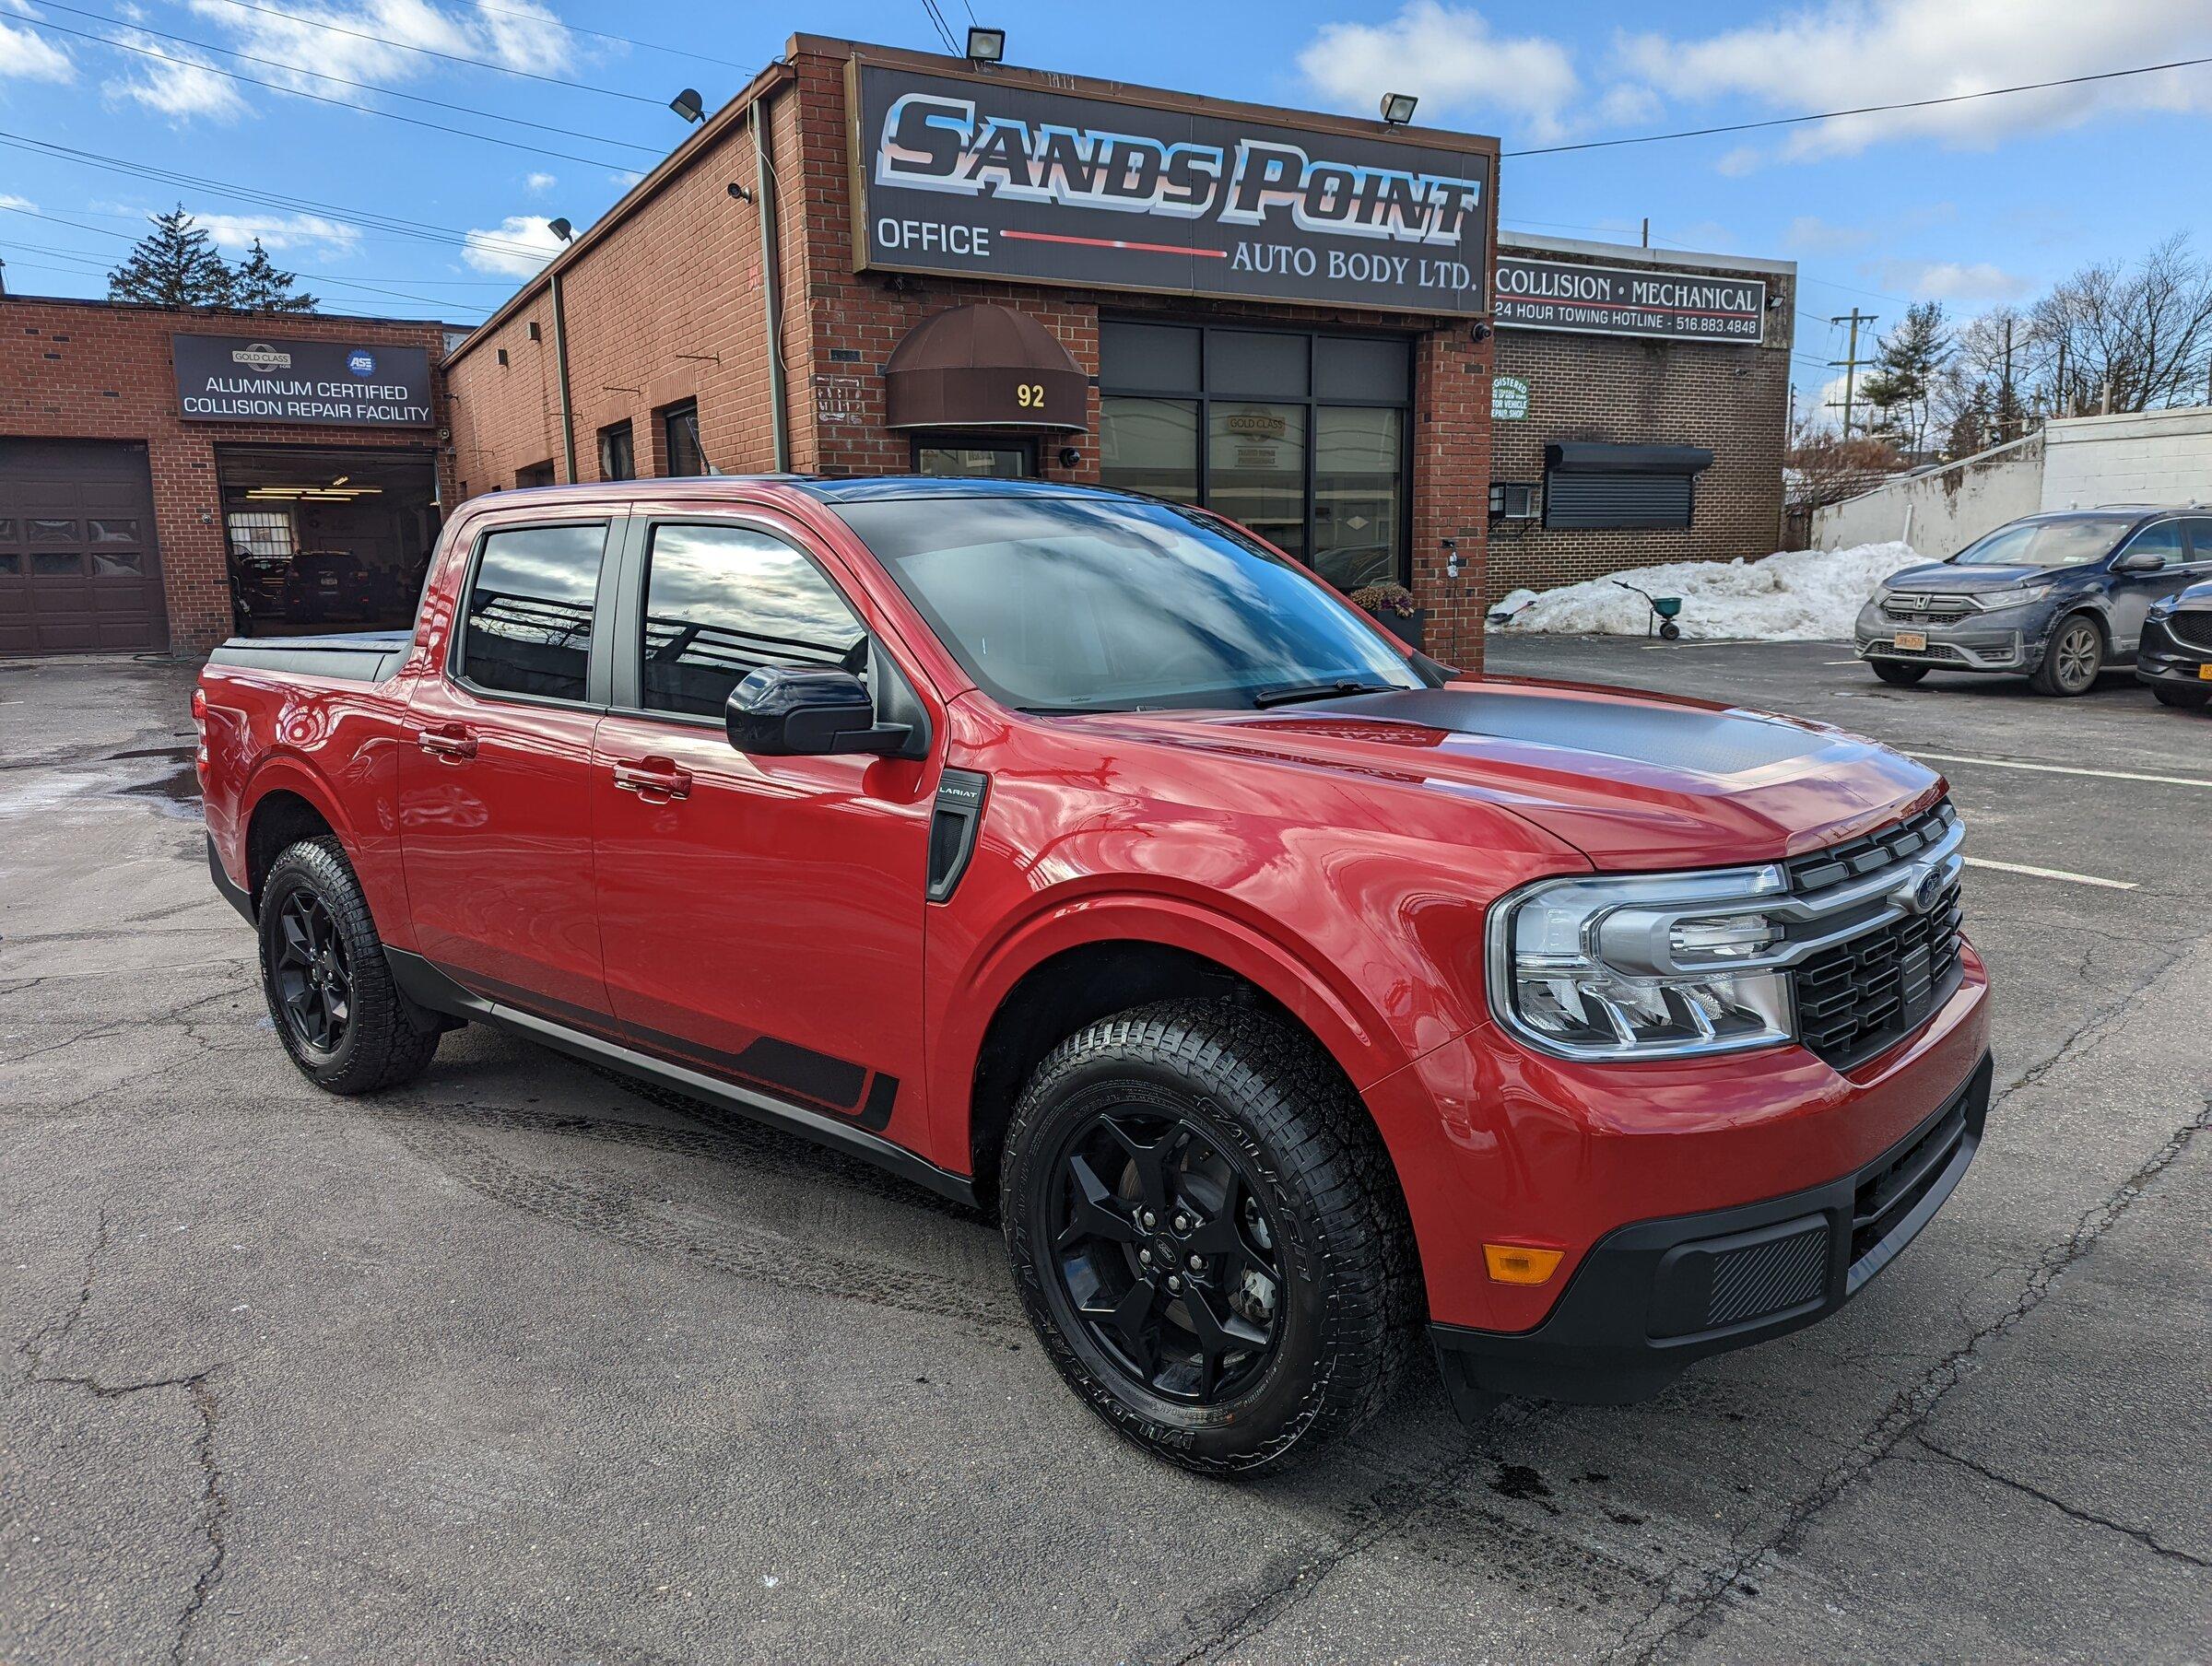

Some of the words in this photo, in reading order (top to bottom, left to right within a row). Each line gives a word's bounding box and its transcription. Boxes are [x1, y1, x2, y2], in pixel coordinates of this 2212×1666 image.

[875, 93, 1224, 219] SANDS
[1217, 138, 1481, 246] POINT
[877, 217, 990, 256] OFFICE
[1231, 241, 1317, 276] AUTO
[1327, 250, 1410, 285] BODY
[1418, 259, 1477, 291] LTD.
[1495, 267, 1611, 301] COLLISION
[1631, 281, 1758, 311] MECHANICAL
[1495, 301, 1512, 316] 24
[1517, 305, 1554, 321] HOUR
[1558, 307, 1608, 324] TOWING
[1612, 311, 1664, 329] HOTLINE
[1677, 317, 1757, 334] 516.883.4848
[235, 353, 260, 361] GOLD
[262, 354, 288, 363] CLASS
[349, 357, 372, 368] ASE
[206, 377, 313, 396] ALUMINUM
[317, 381, 408, 401] CERTIFIED
[1018, 383, 1044, 407] 92
[1491, 377, 1527, 393] GISTERED
[184, 397, 282, 416] COLLISION
[288, 402, 352, 418] REPAIR
[357, 404, 429, 422] FACILITY
[1490, 408, 1508, 417] EPAIR
[1509, 409, 1524, 418] SHOP
[1491, 399, 1503, 408] TOR
[1230, 418, 1254, 428] GOLD
[1256, 419, 1284, 429] CLASS
[939, 786, 978, 798] LARIAT
